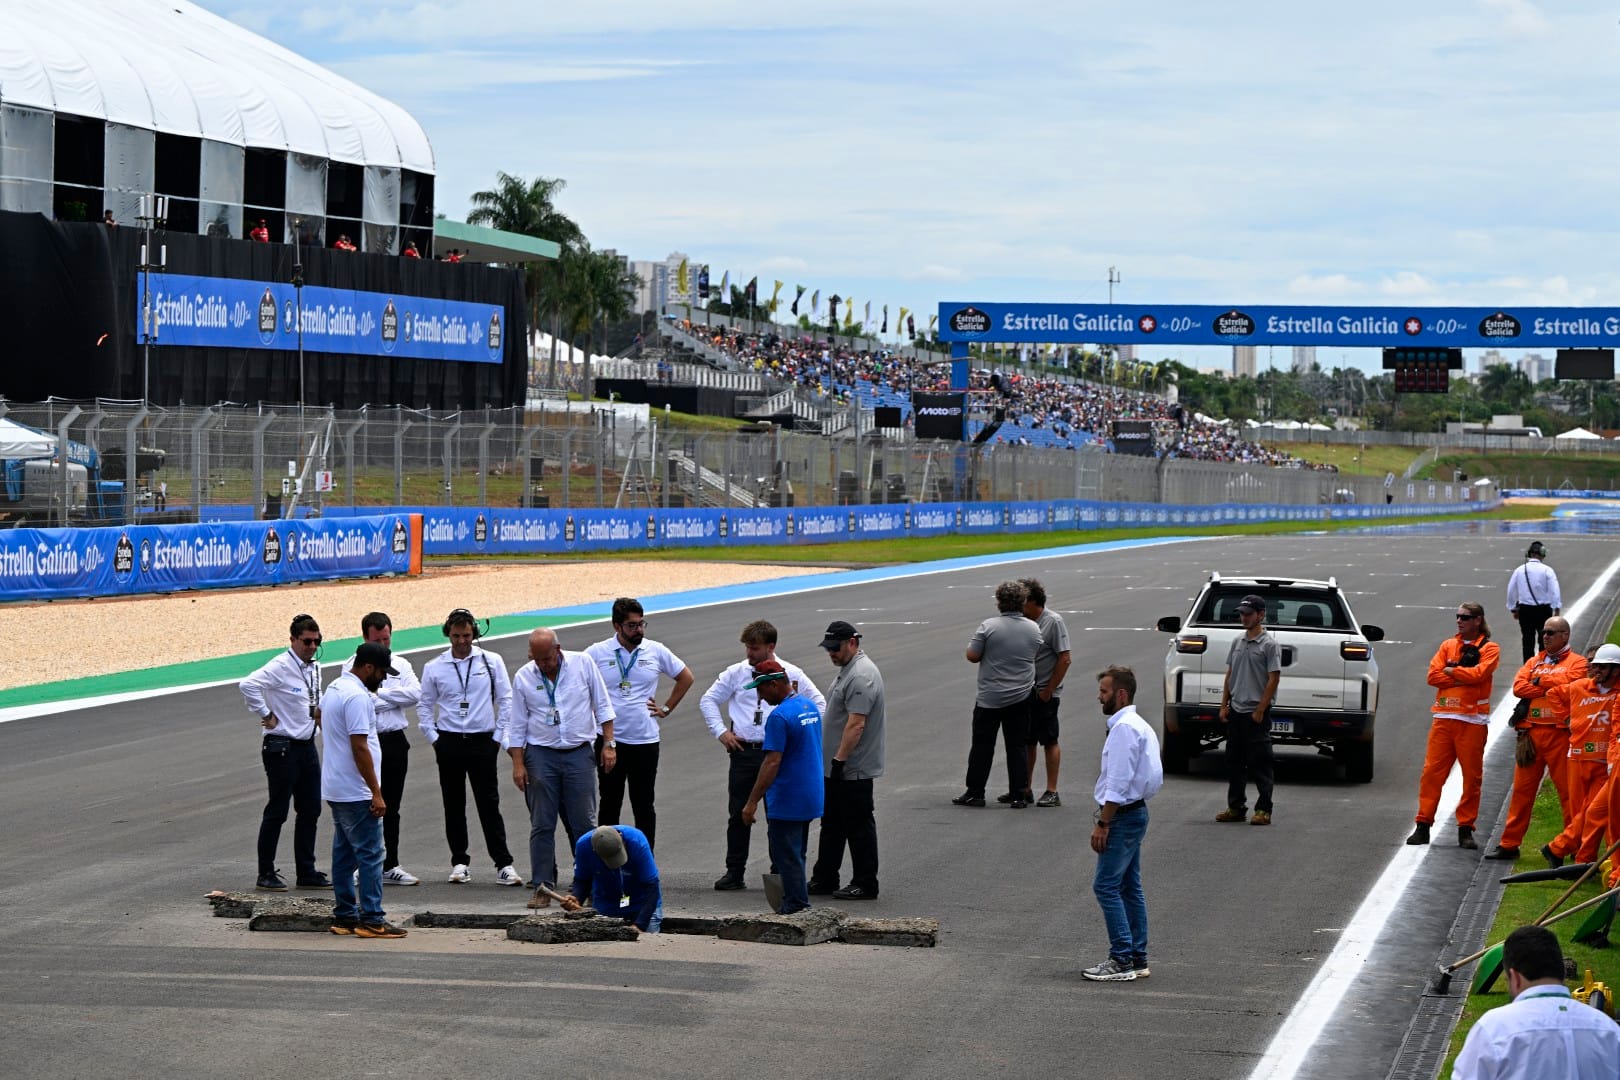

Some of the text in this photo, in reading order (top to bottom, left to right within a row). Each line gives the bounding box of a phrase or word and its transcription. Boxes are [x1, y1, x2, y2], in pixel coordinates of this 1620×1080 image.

[194, 293, 228, 328] Galicia
[327, 304, 358, 336] Galicia
[956, 314, 985, 322] Estrella
[413, 312, 441, 342] Estrella
[442, 314, 467, 345] Galicia
[957, 322, 984, 330] Galicia
[1002, 312, 1070, 331] Estrella
[1072, 313, 1135, 332] Galicia
[1170, 316, 1191, 332] 0,0
[1219, 318, 1248, 326] Estrella
[1220, 325, 1247, 333] Galicia
[1266, 315, 1457, 335] Estrella Galicia 0,0
[1484, 319, 1515, 328] Estrella
[1485, 327, 1514, 336] Galicia
[1533, 317, 1620, 336] Estrella G
[429, 517, 454, 542] Galicia
[500, 518, 524, 541] Estrella
[524, 517, 547, 542] Galicia
[153, 538, 194, 570] Estrella
[194, 536, 231, 568] Galicia
[297, 530, 335, 561] Estrella
[335, 528, 366, 558] Galicia
[36, 541, 78, 576] Galicia
